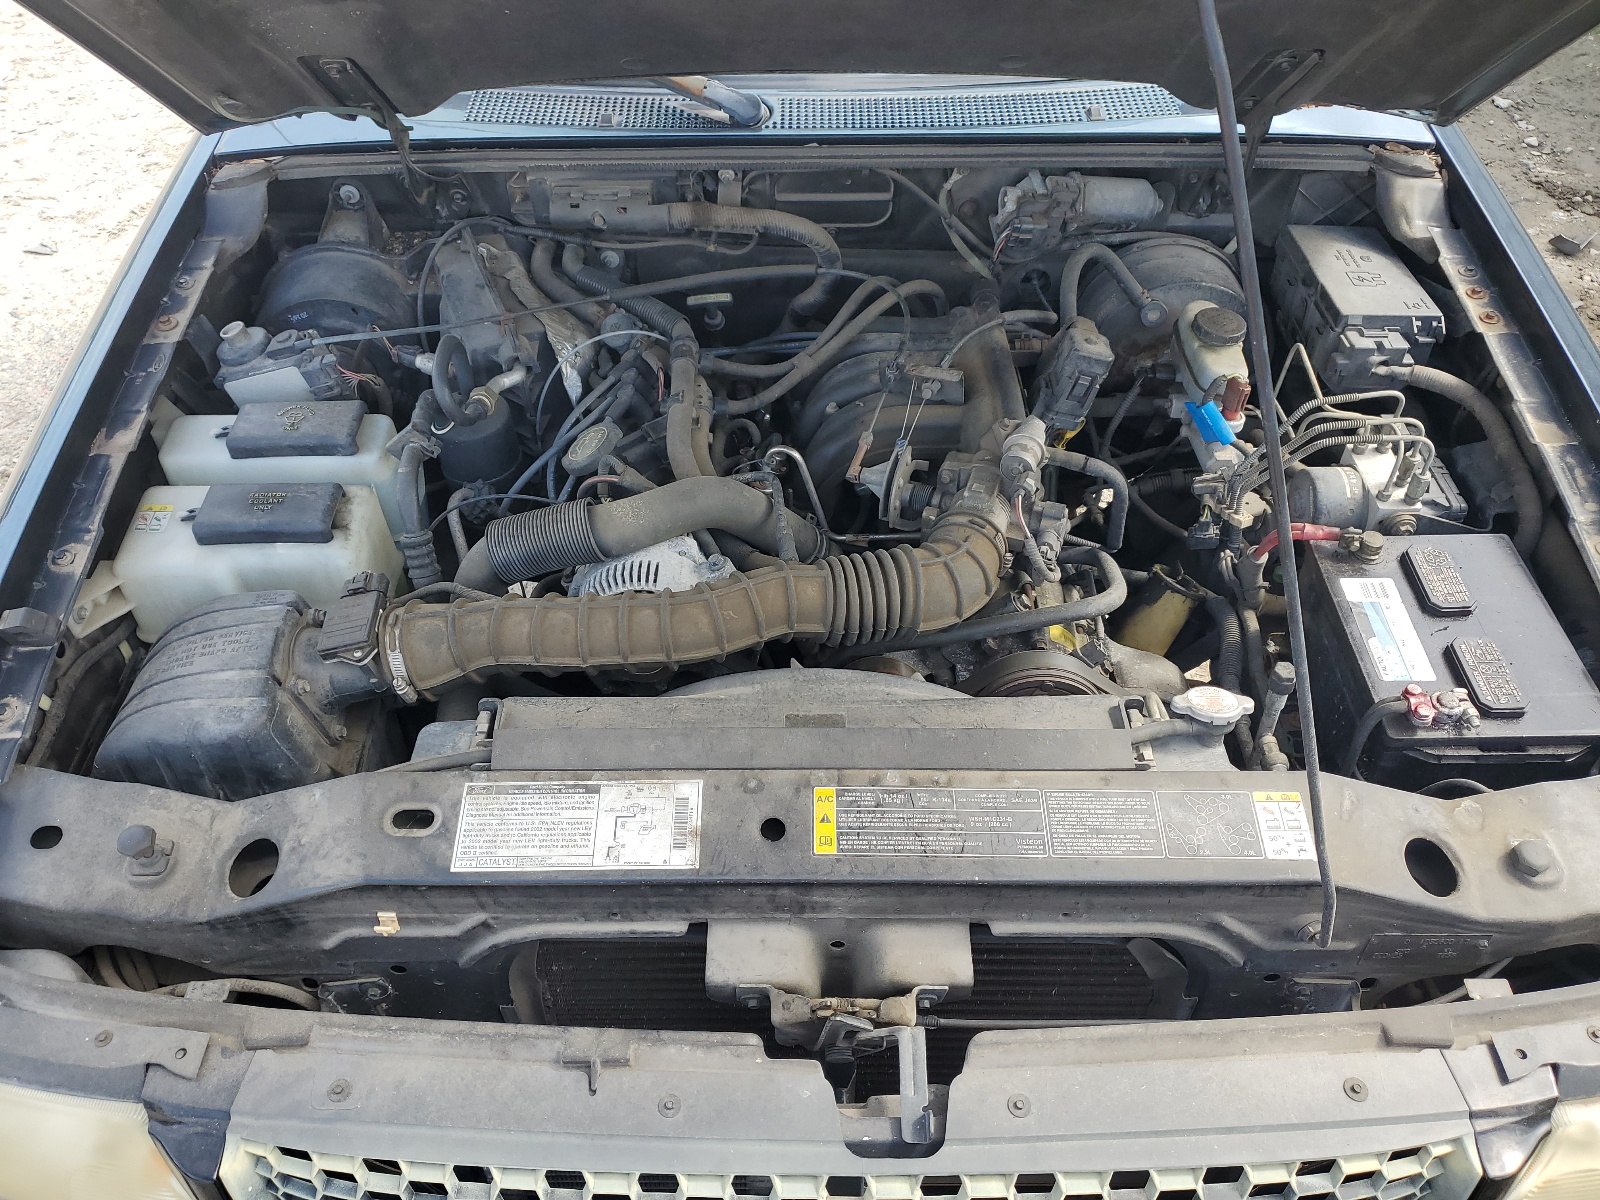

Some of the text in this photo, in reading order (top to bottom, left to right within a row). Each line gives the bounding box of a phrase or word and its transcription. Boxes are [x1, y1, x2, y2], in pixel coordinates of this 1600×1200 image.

[467, 786, 491, 794] Ford
[816, 795, 834, 803] A/C
[478, 858, 516, 866] CATALYST
